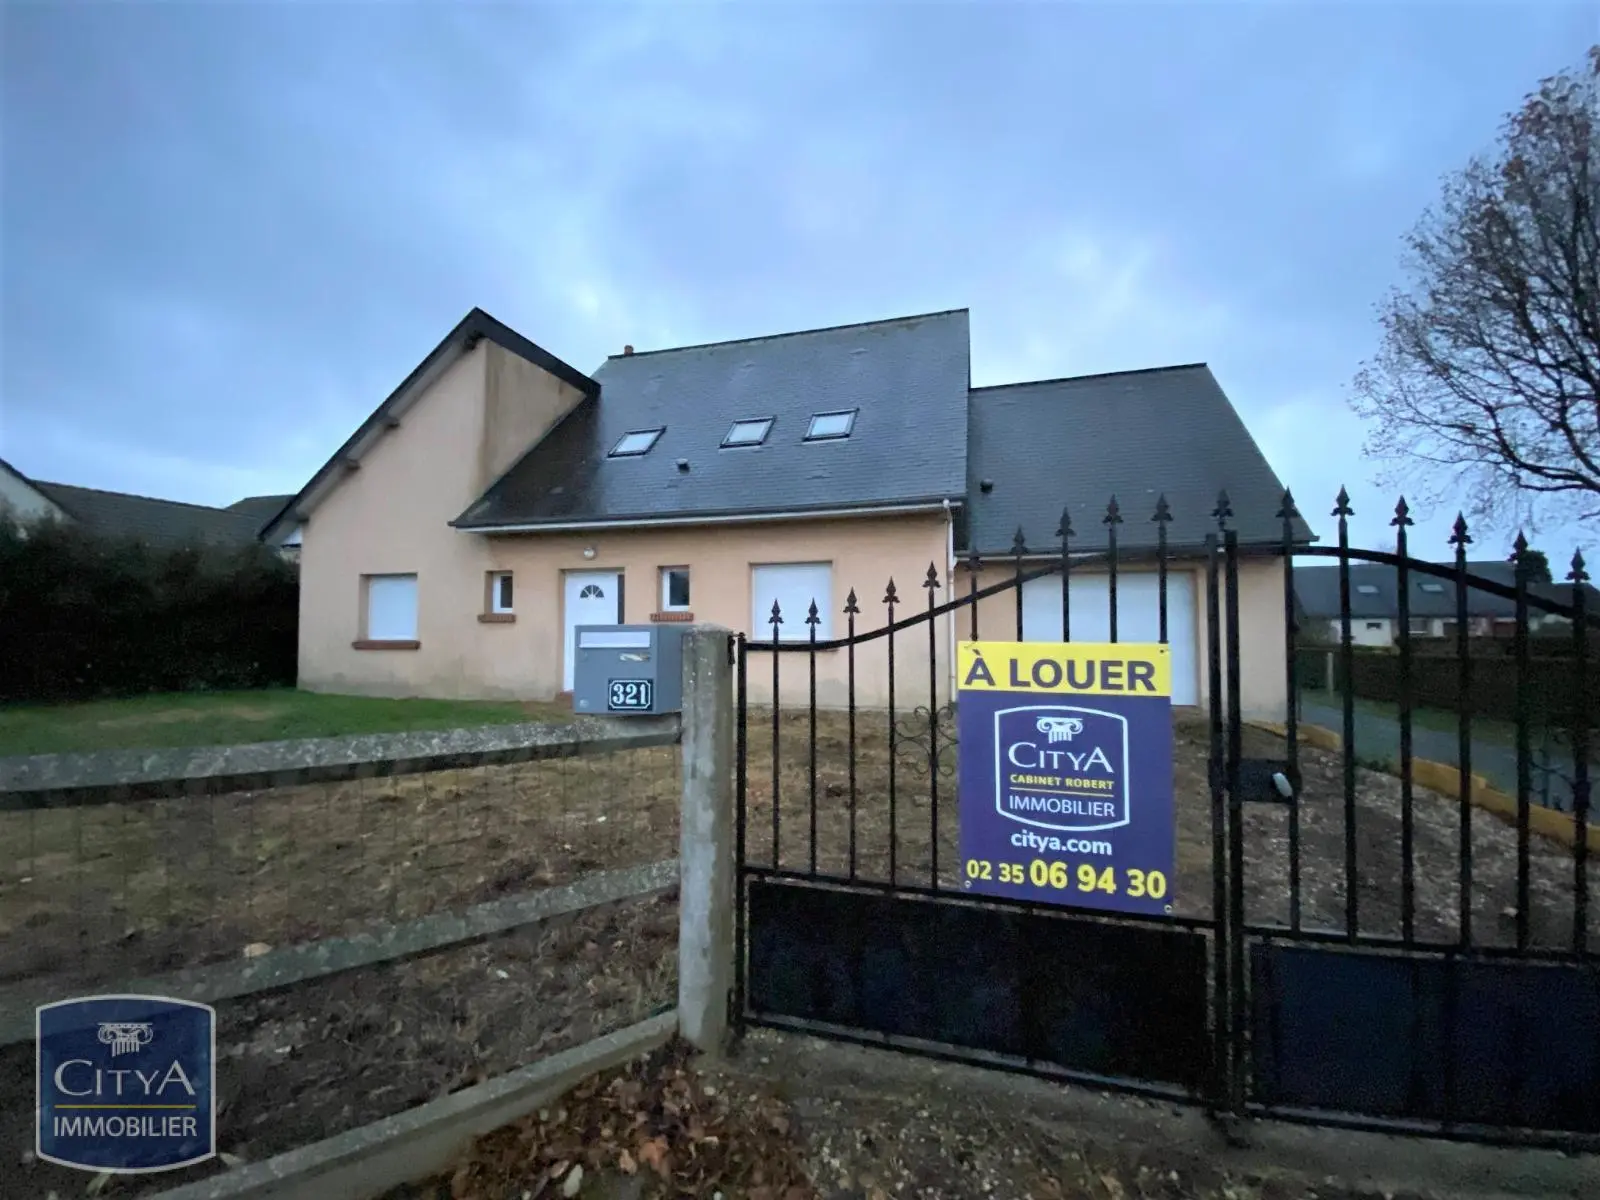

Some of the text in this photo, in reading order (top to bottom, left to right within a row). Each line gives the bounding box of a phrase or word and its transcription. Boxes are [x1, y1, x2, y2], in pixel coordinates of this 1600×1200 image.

[964, 649, 1157, 692] À LOUER
[612, 683, 647, 705] 321
[1008, 741, 1115, 773] CITYA
[1010, 774, 1115, 790] CABINET ROBERT
[1009, 795, 1116, 817] IMMOBILIER
[1010, 829, 1113, 856] citya.com
[966, 858, 1167, 899] 02 35 06 94 30
